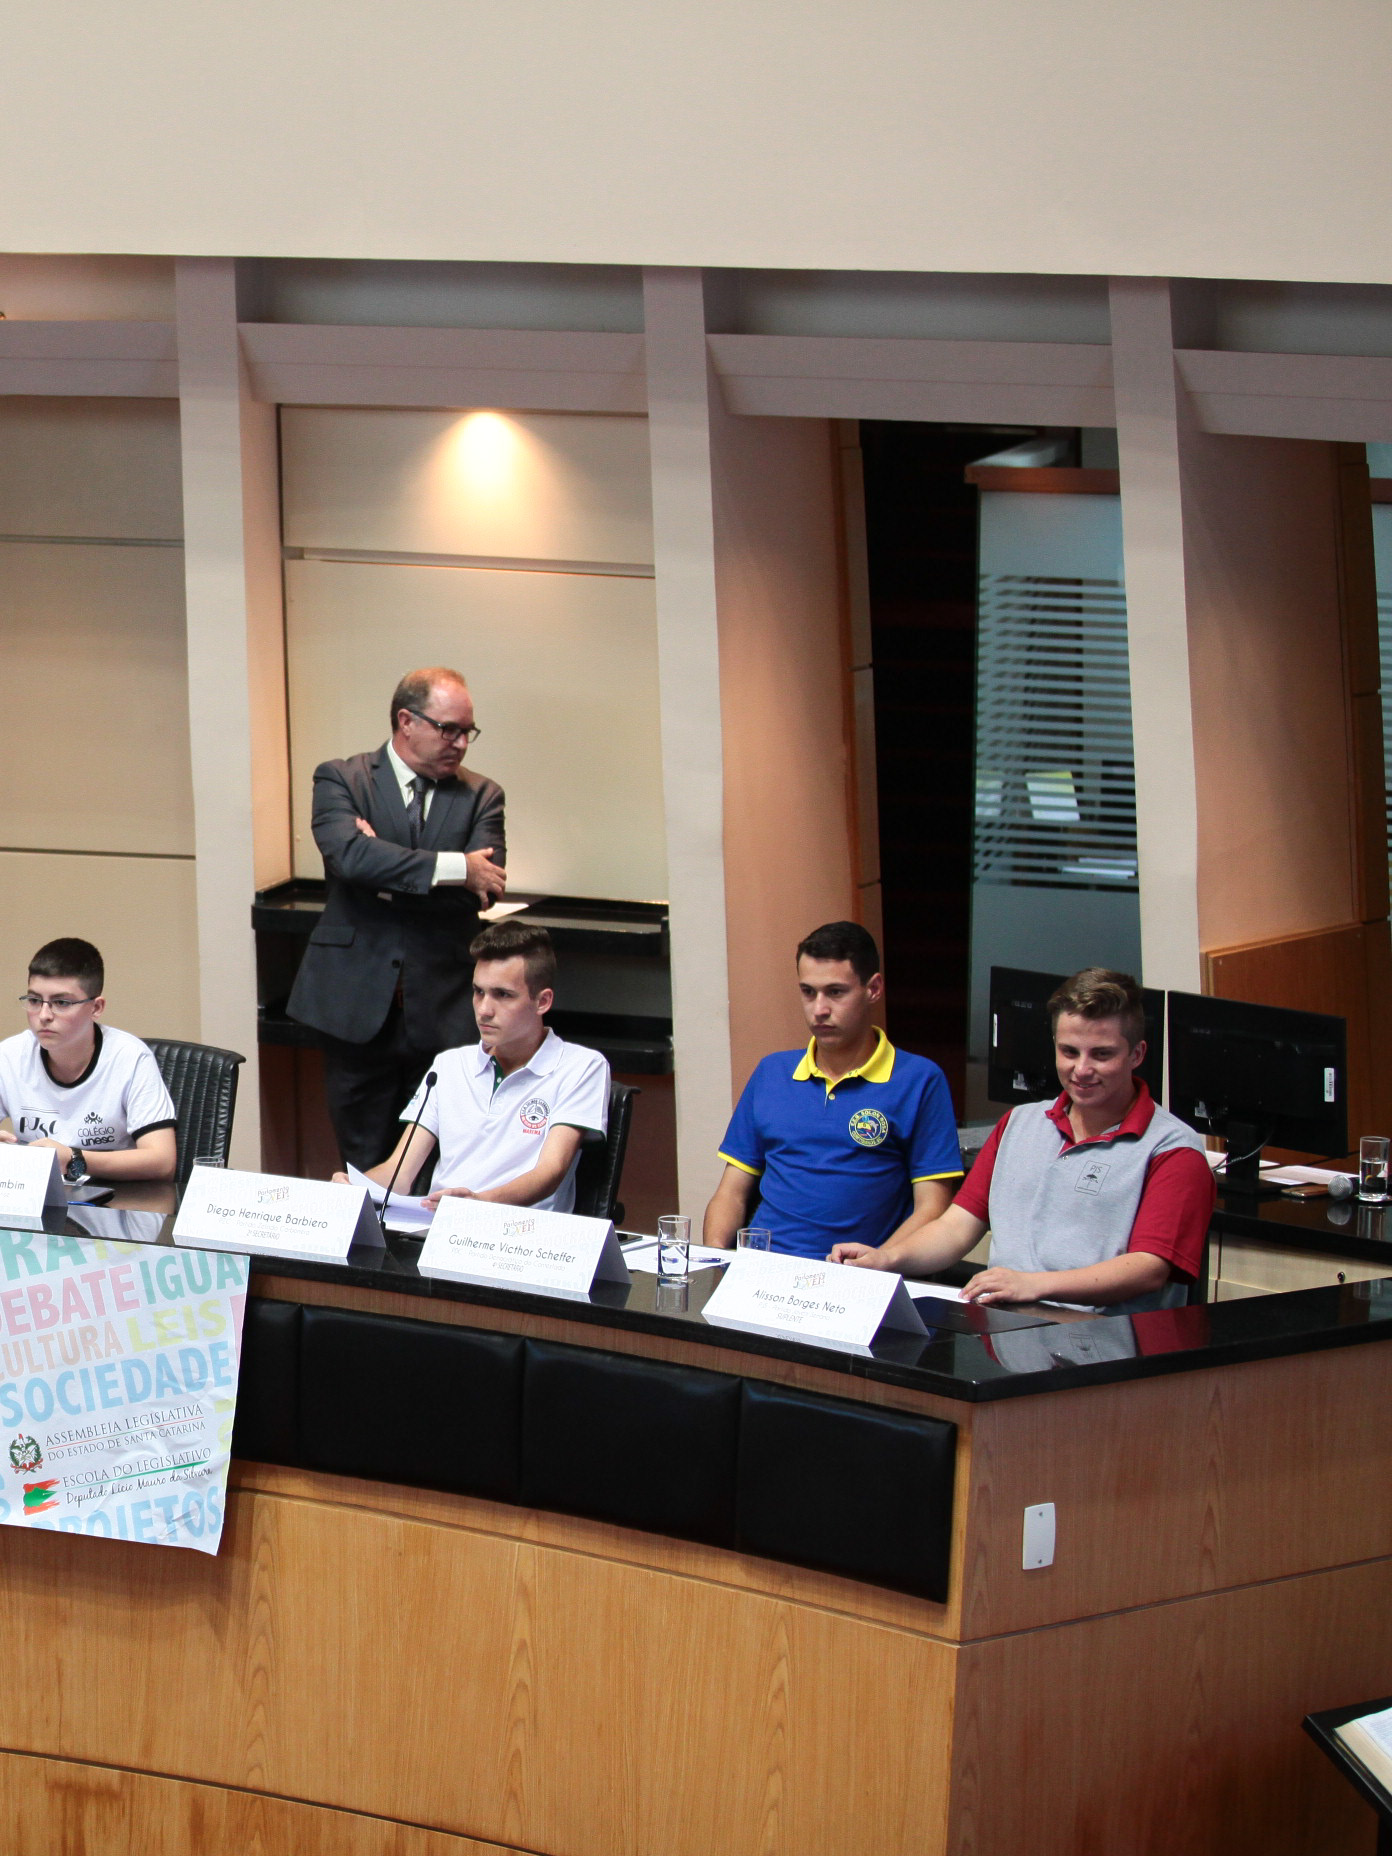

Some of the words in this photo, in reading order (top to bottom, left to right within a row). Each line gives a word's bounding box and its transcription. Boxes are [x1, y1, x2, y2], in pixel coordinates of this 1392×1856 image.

[77, 1126, 115, 1138] COLÉGIO
[81, 1135, 116, 1147] unesc
[206, 1203, 236, 1218] Diego
[239, 1208, 282, 1223] Henrique
[285, 1213, 329, 1229] Barbiero
[448, 1234, 496, 1251] Guilherme
[499, 1242, 534, 1257] Victhor
[535, 1248, 577, 1264] Scheffer
[139, 1250, 250, 1305] IGUA
[752, 1288, 786, 1304] Alisson
[787, 1294, 820, 1310] Borges
[822, 1300, 846, 1315] Neto
[126, 1299, 227, 1353] LEIS
[45, 1420, 122, 1448] ASSEMBLEIA
[125, 1403, 204, 1431] LEGISLATIVA
[48, 1450, 65, 1462] DO
[65, 1441, 105, 1459] ESTADO
[108, 1437, 122, 1449] DE
[125, 1431, 157, 1446] SANTA
[158, 1420, 206, 1438] CATARINA
[63, 1468, 110, 1489] ESCOLA
[113, 1463, 134, 1477] DO
[137, 1447, 212, 1473] LEGISLATIVO
[66, 1486, 108, 1509] Deputado
[136, 1476, 167, 1492] Mauro
[169, 1469, 182, 1483] da
